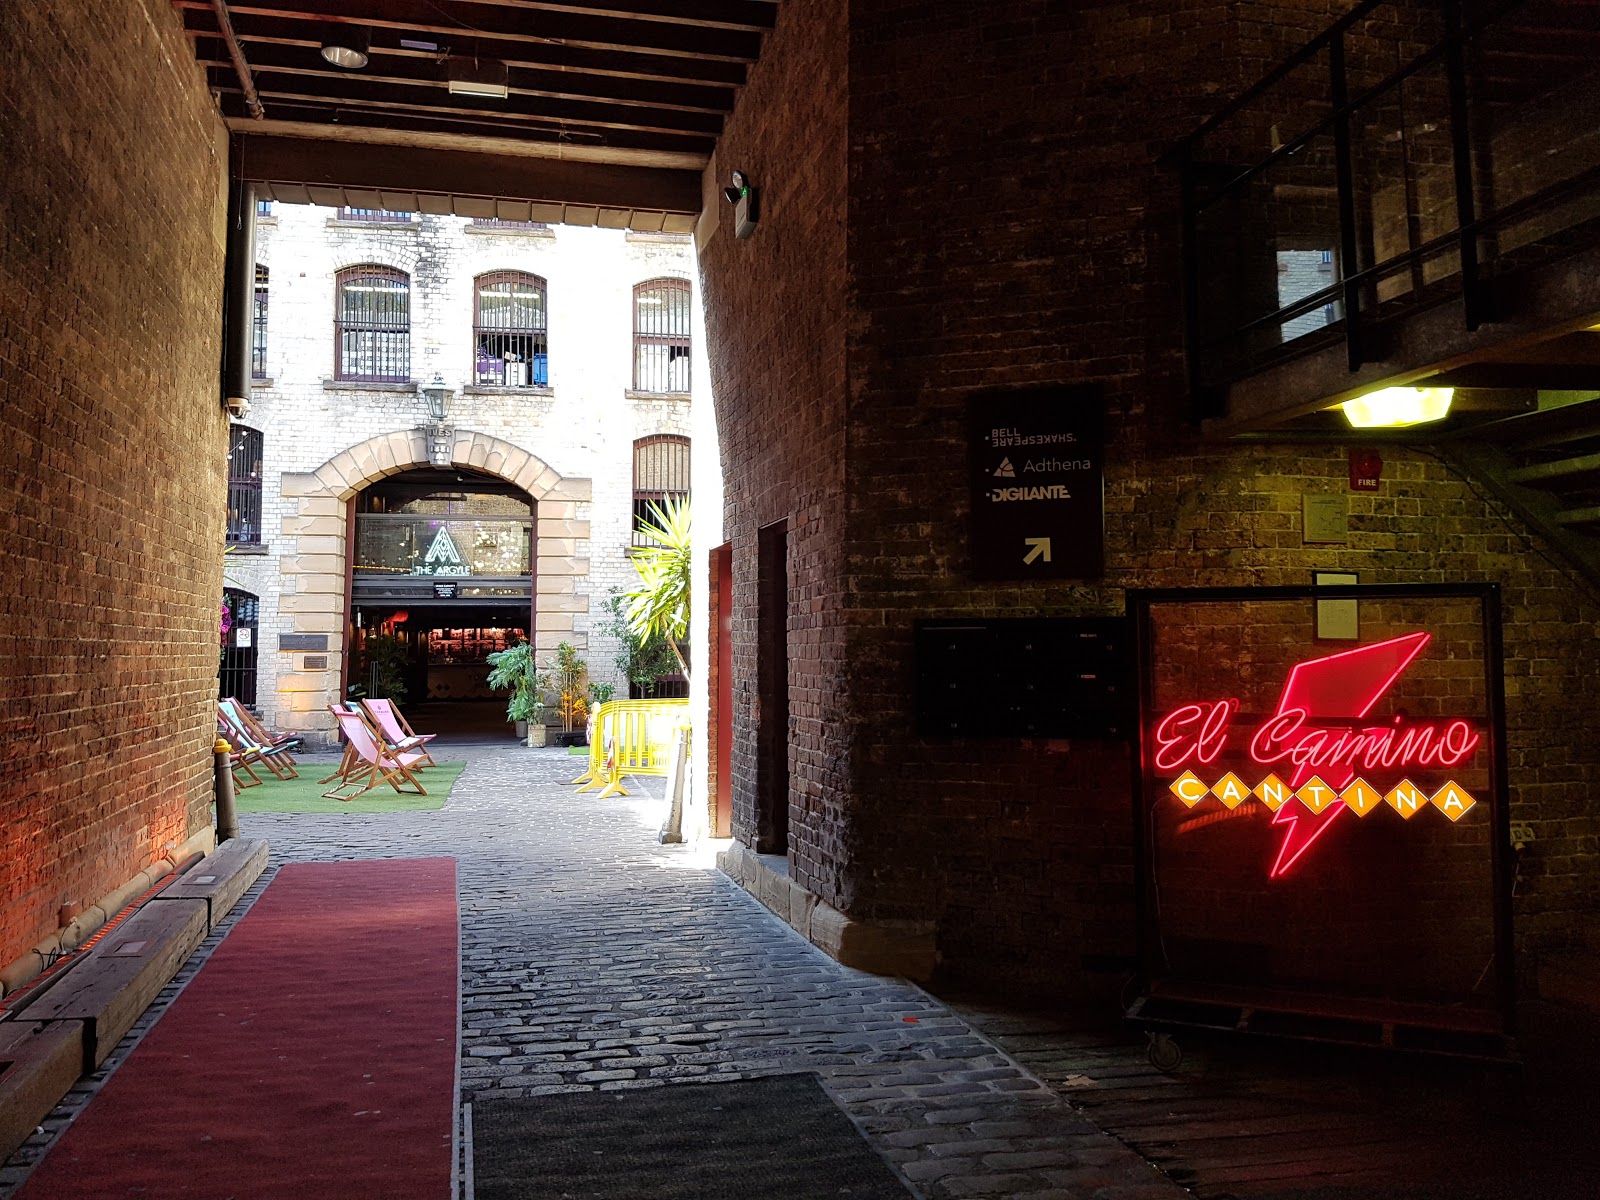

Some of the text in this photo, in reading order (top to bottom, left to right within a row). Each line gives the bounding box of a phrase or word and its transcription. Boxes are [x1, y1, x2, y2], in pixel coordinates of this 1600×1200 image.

[992, 428, 1021, 438] BELL
[992, 433, 1074, 447] SHAKESPEARE
[1022, 457, 1091, 473] Adthena
[1358, 478, 1377, 487] FIRE
[992, 485, 1072, 502] DIGILANTE
[415, 565, 471, 575] THE ARGYLE
[1154, 699, 1480, 770] El Camino
[1174, 777, 1467, 814] CANTINA
